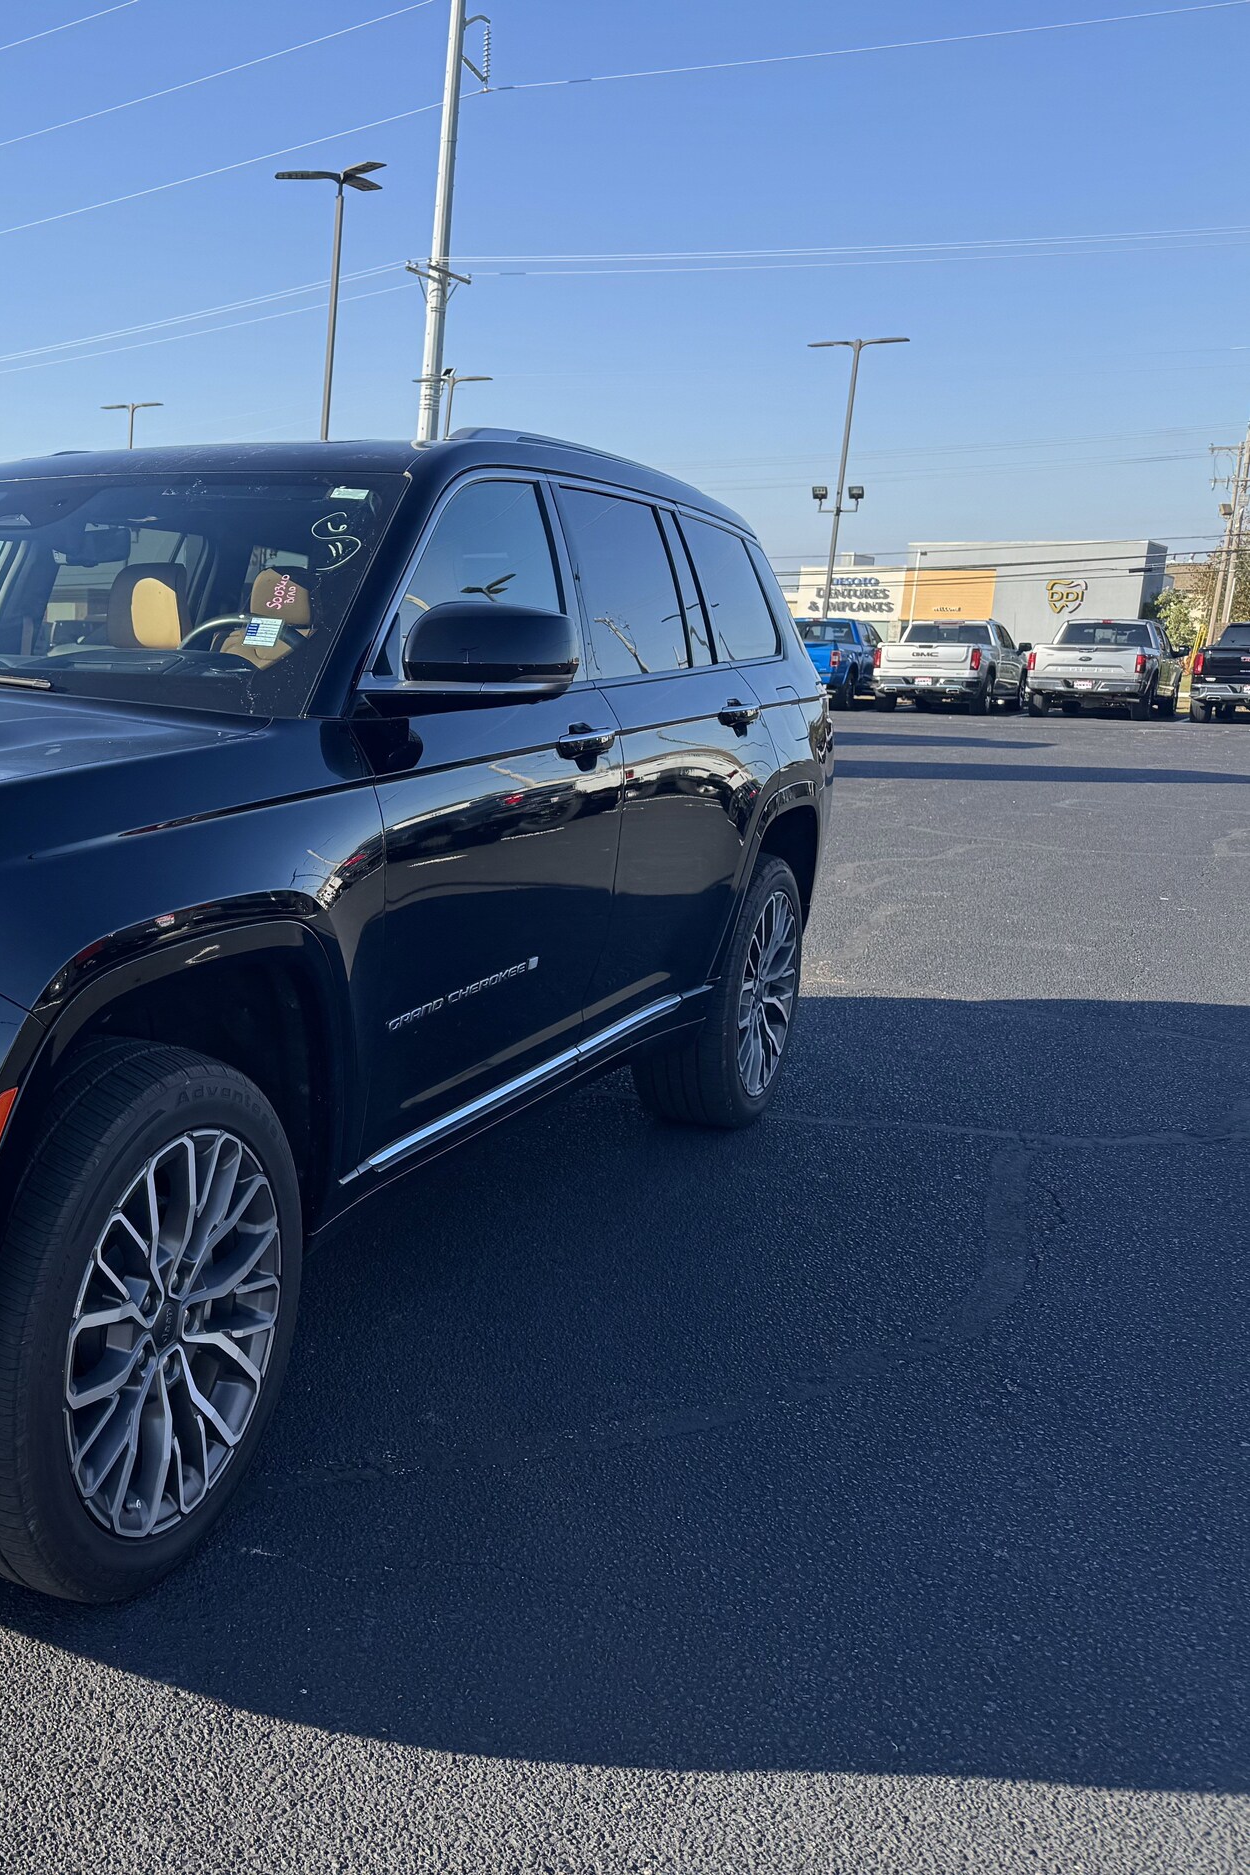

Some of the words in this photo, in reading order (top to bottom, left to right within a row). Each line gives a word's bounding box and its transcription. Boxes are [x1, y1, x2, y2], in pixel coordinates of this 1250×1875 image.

[816, 587, 890, 600] DENTURES
[1048, 589, 1084, 602] DDI
[823, 601, 894, 613] MPLANTS
[388, 996, 445, 1032] GRAND
[447, 961, 528, 1005] CHEROKEE
